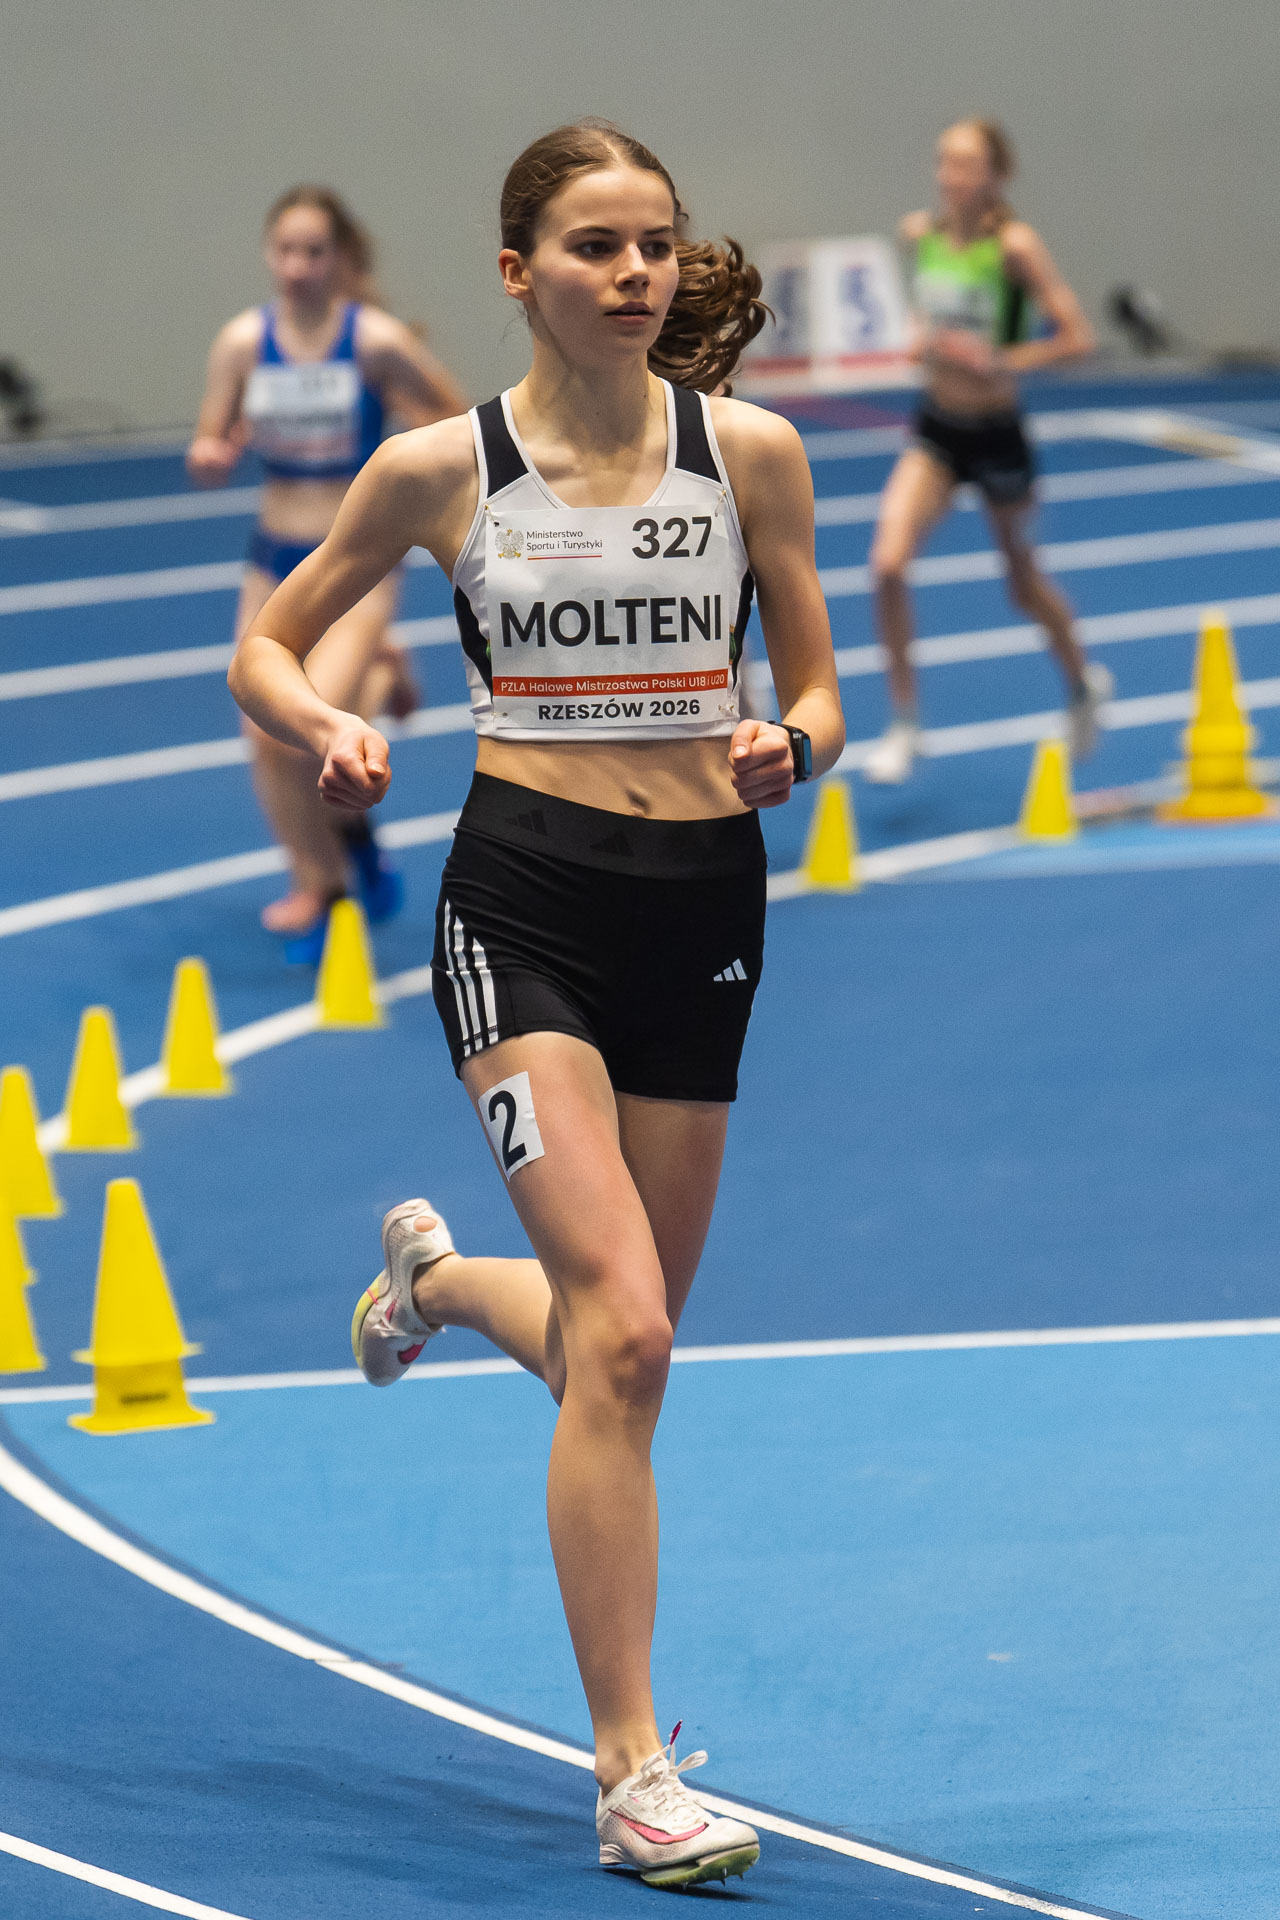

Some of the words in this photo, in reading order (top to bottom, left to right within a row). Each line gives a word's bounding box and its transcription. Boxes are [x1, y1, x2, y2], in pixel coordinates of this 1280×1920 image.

[526, 530, 584, 539] Ministerstwo
[526, 542, 555, 551] Sportu
[562, 540, 603, 549] Turystyki
[632, 516, 712, 559] 327
[500, 594, 721, 647] MOLTENI
[501, 681, 527, 692] PZLA
[529, 682, 573, 692] Halowe
[576, 680, 649, 692] Mistrzostwa
[652, 677, 686, 689] Polski
[688, 676, 706, 687] U18
[711, 674, 725, 686] U20
[538, 698, 643, 721] RZESZÓW
[649, 699, 700, 717] 2026
[488, 1090, 527, 1171] 2
